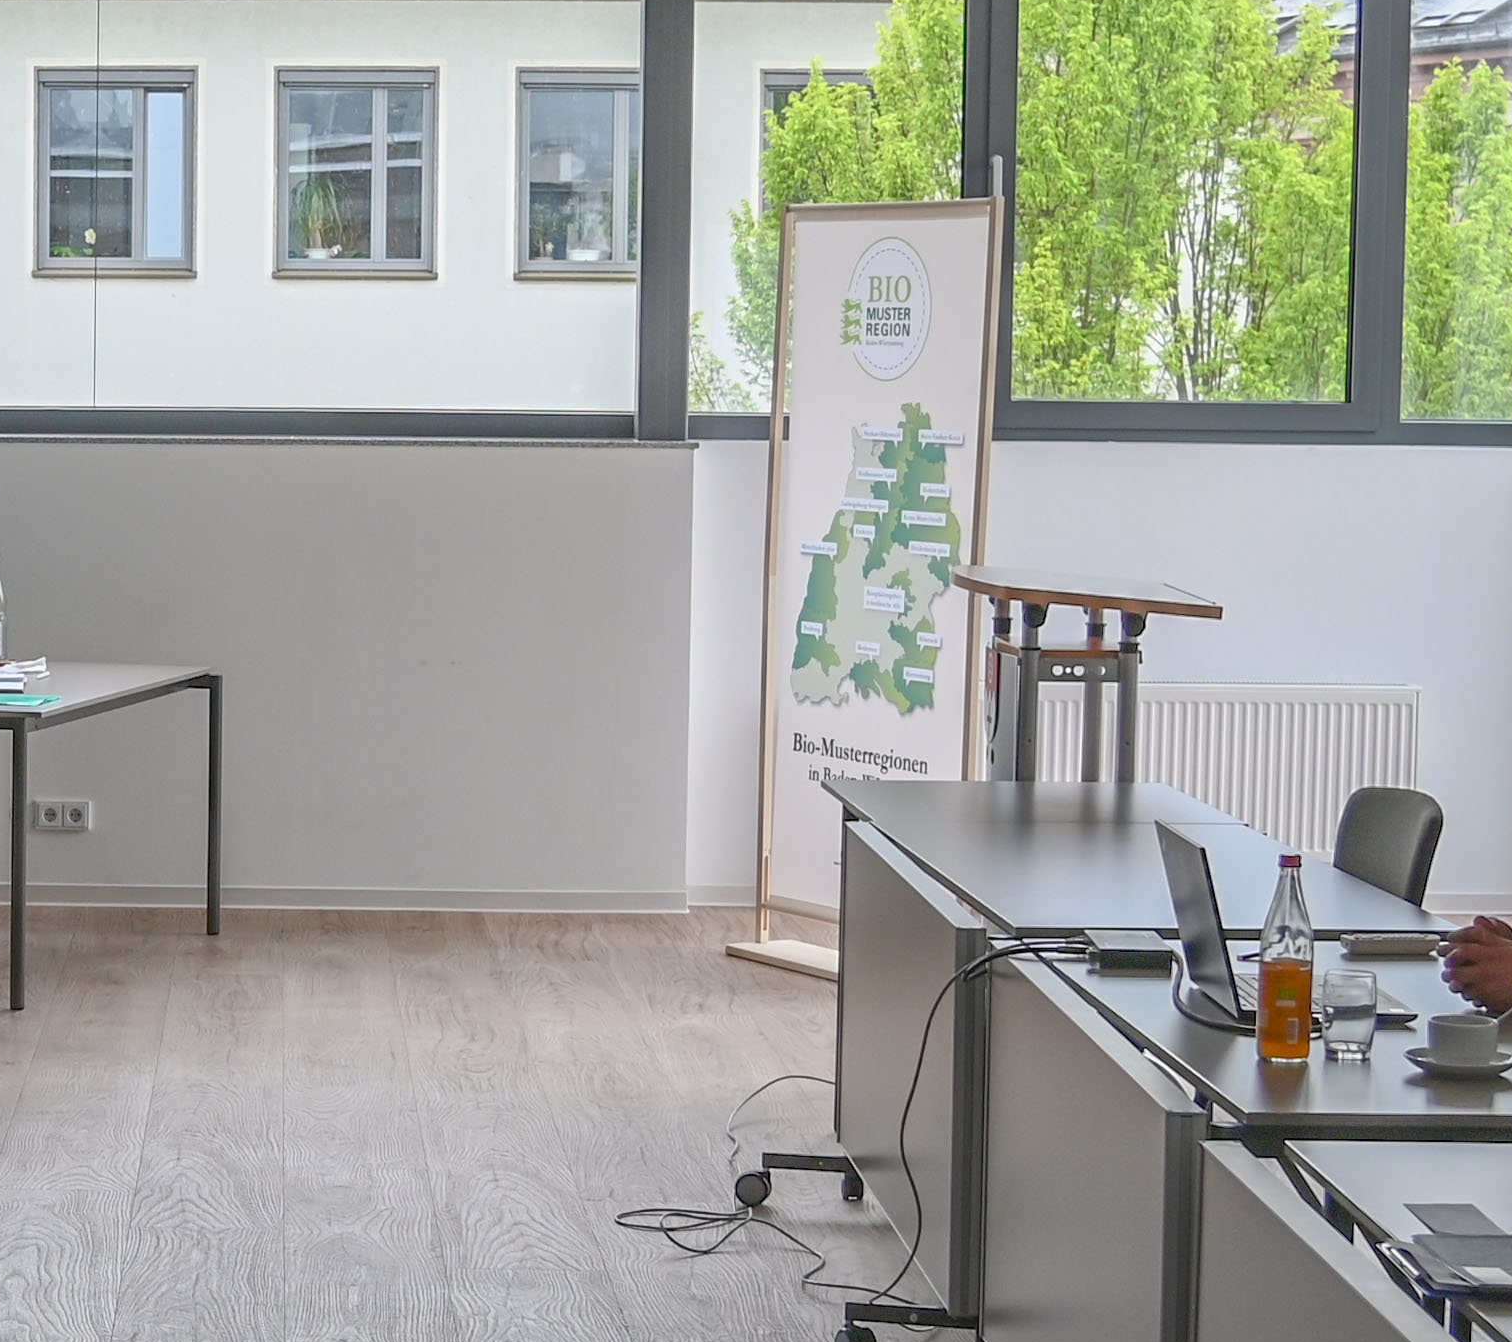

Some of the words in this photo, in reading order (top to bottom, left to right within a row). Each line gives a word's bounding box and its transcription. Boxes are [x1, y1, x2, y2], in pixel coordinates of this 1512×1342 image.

[867, 275, 912, 303] BIO
[866, 307, 911, 321] MUSTER
[865, 323, 911, 337] REGION
[792, 732, 929, 775] Bio-Musterregionen
[808, 764, 820, 782] in
